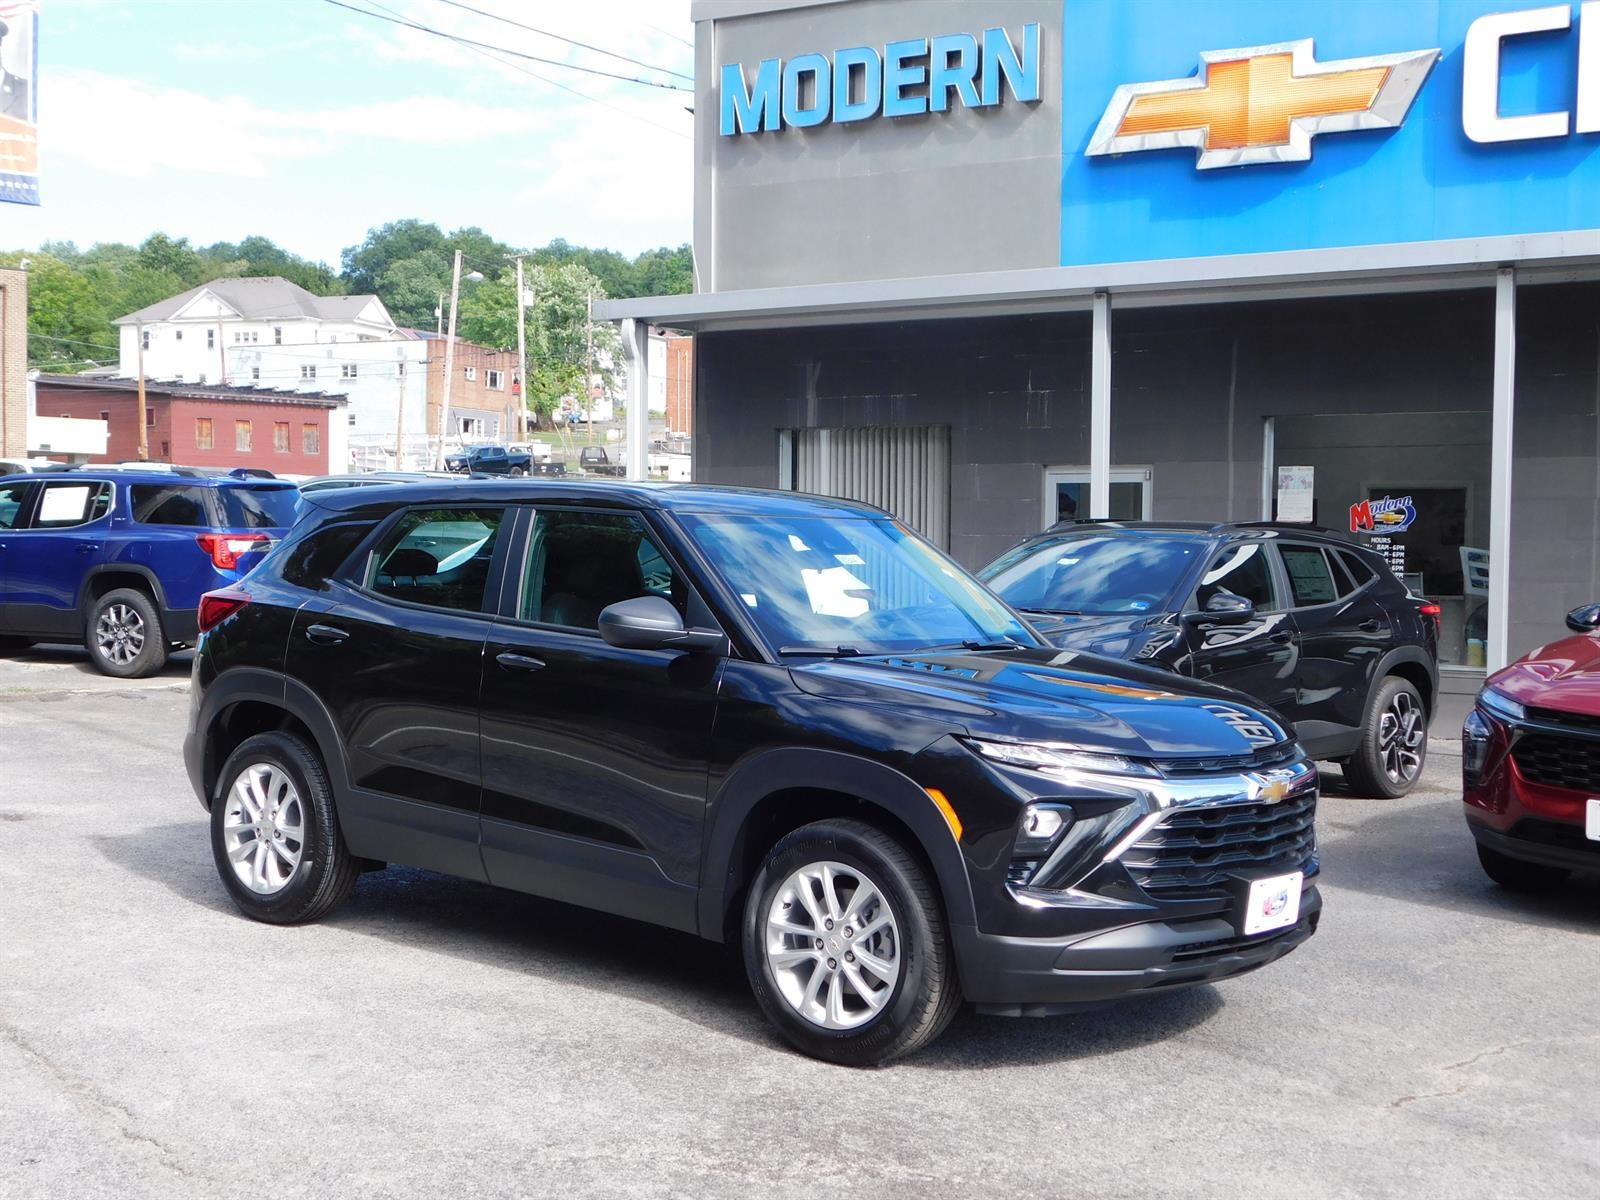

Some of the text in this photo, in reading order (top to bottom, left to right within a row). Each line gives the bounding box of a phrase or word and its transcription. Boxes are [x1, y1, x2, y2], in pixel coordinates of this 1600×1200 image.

[719, 22, 1042, 136] MODERN
[1462, 0, 1600, 144] C
[1350, 495, 1412, 533] Modern
